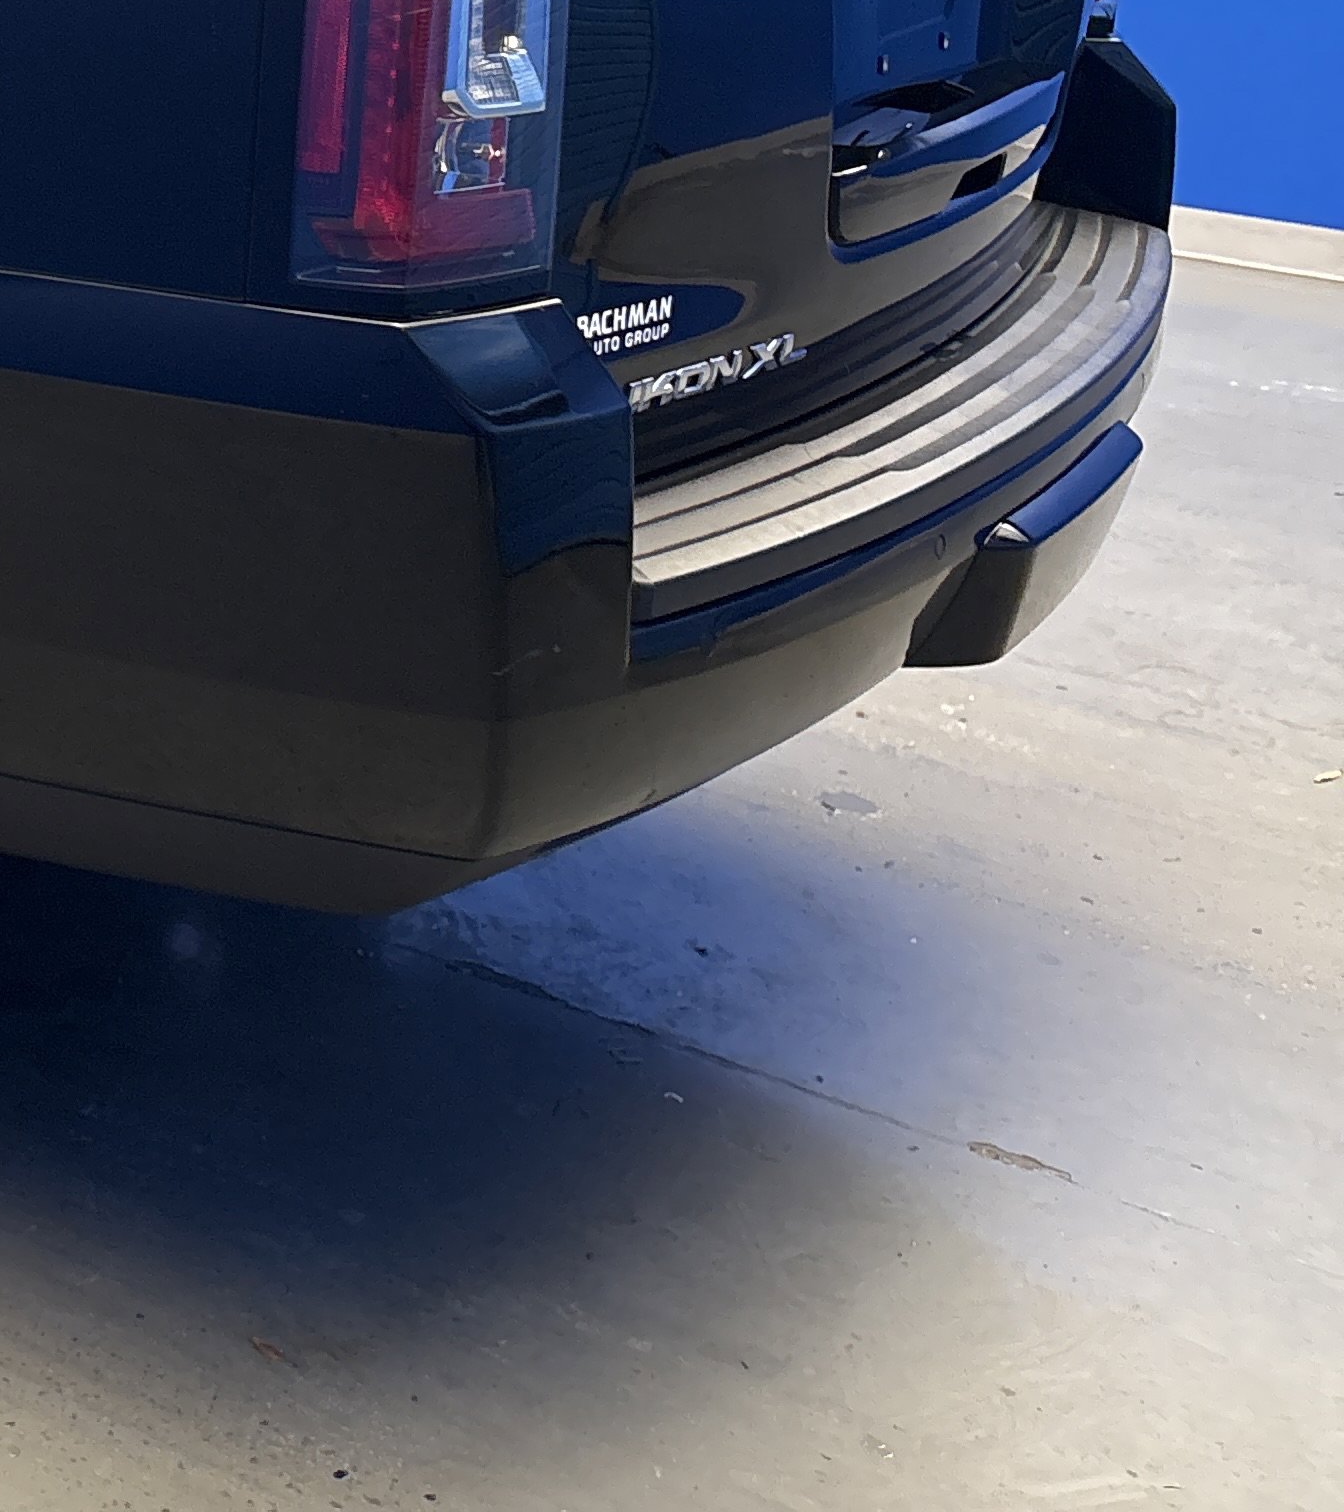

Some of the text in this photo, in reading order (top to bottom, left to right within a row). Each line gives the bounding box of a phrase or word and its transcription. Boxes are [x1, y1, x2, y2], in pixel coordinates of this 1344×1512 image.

[593, 322, 670, 356] UTO GROUP
[628, 333, 808, 413] KON XL
